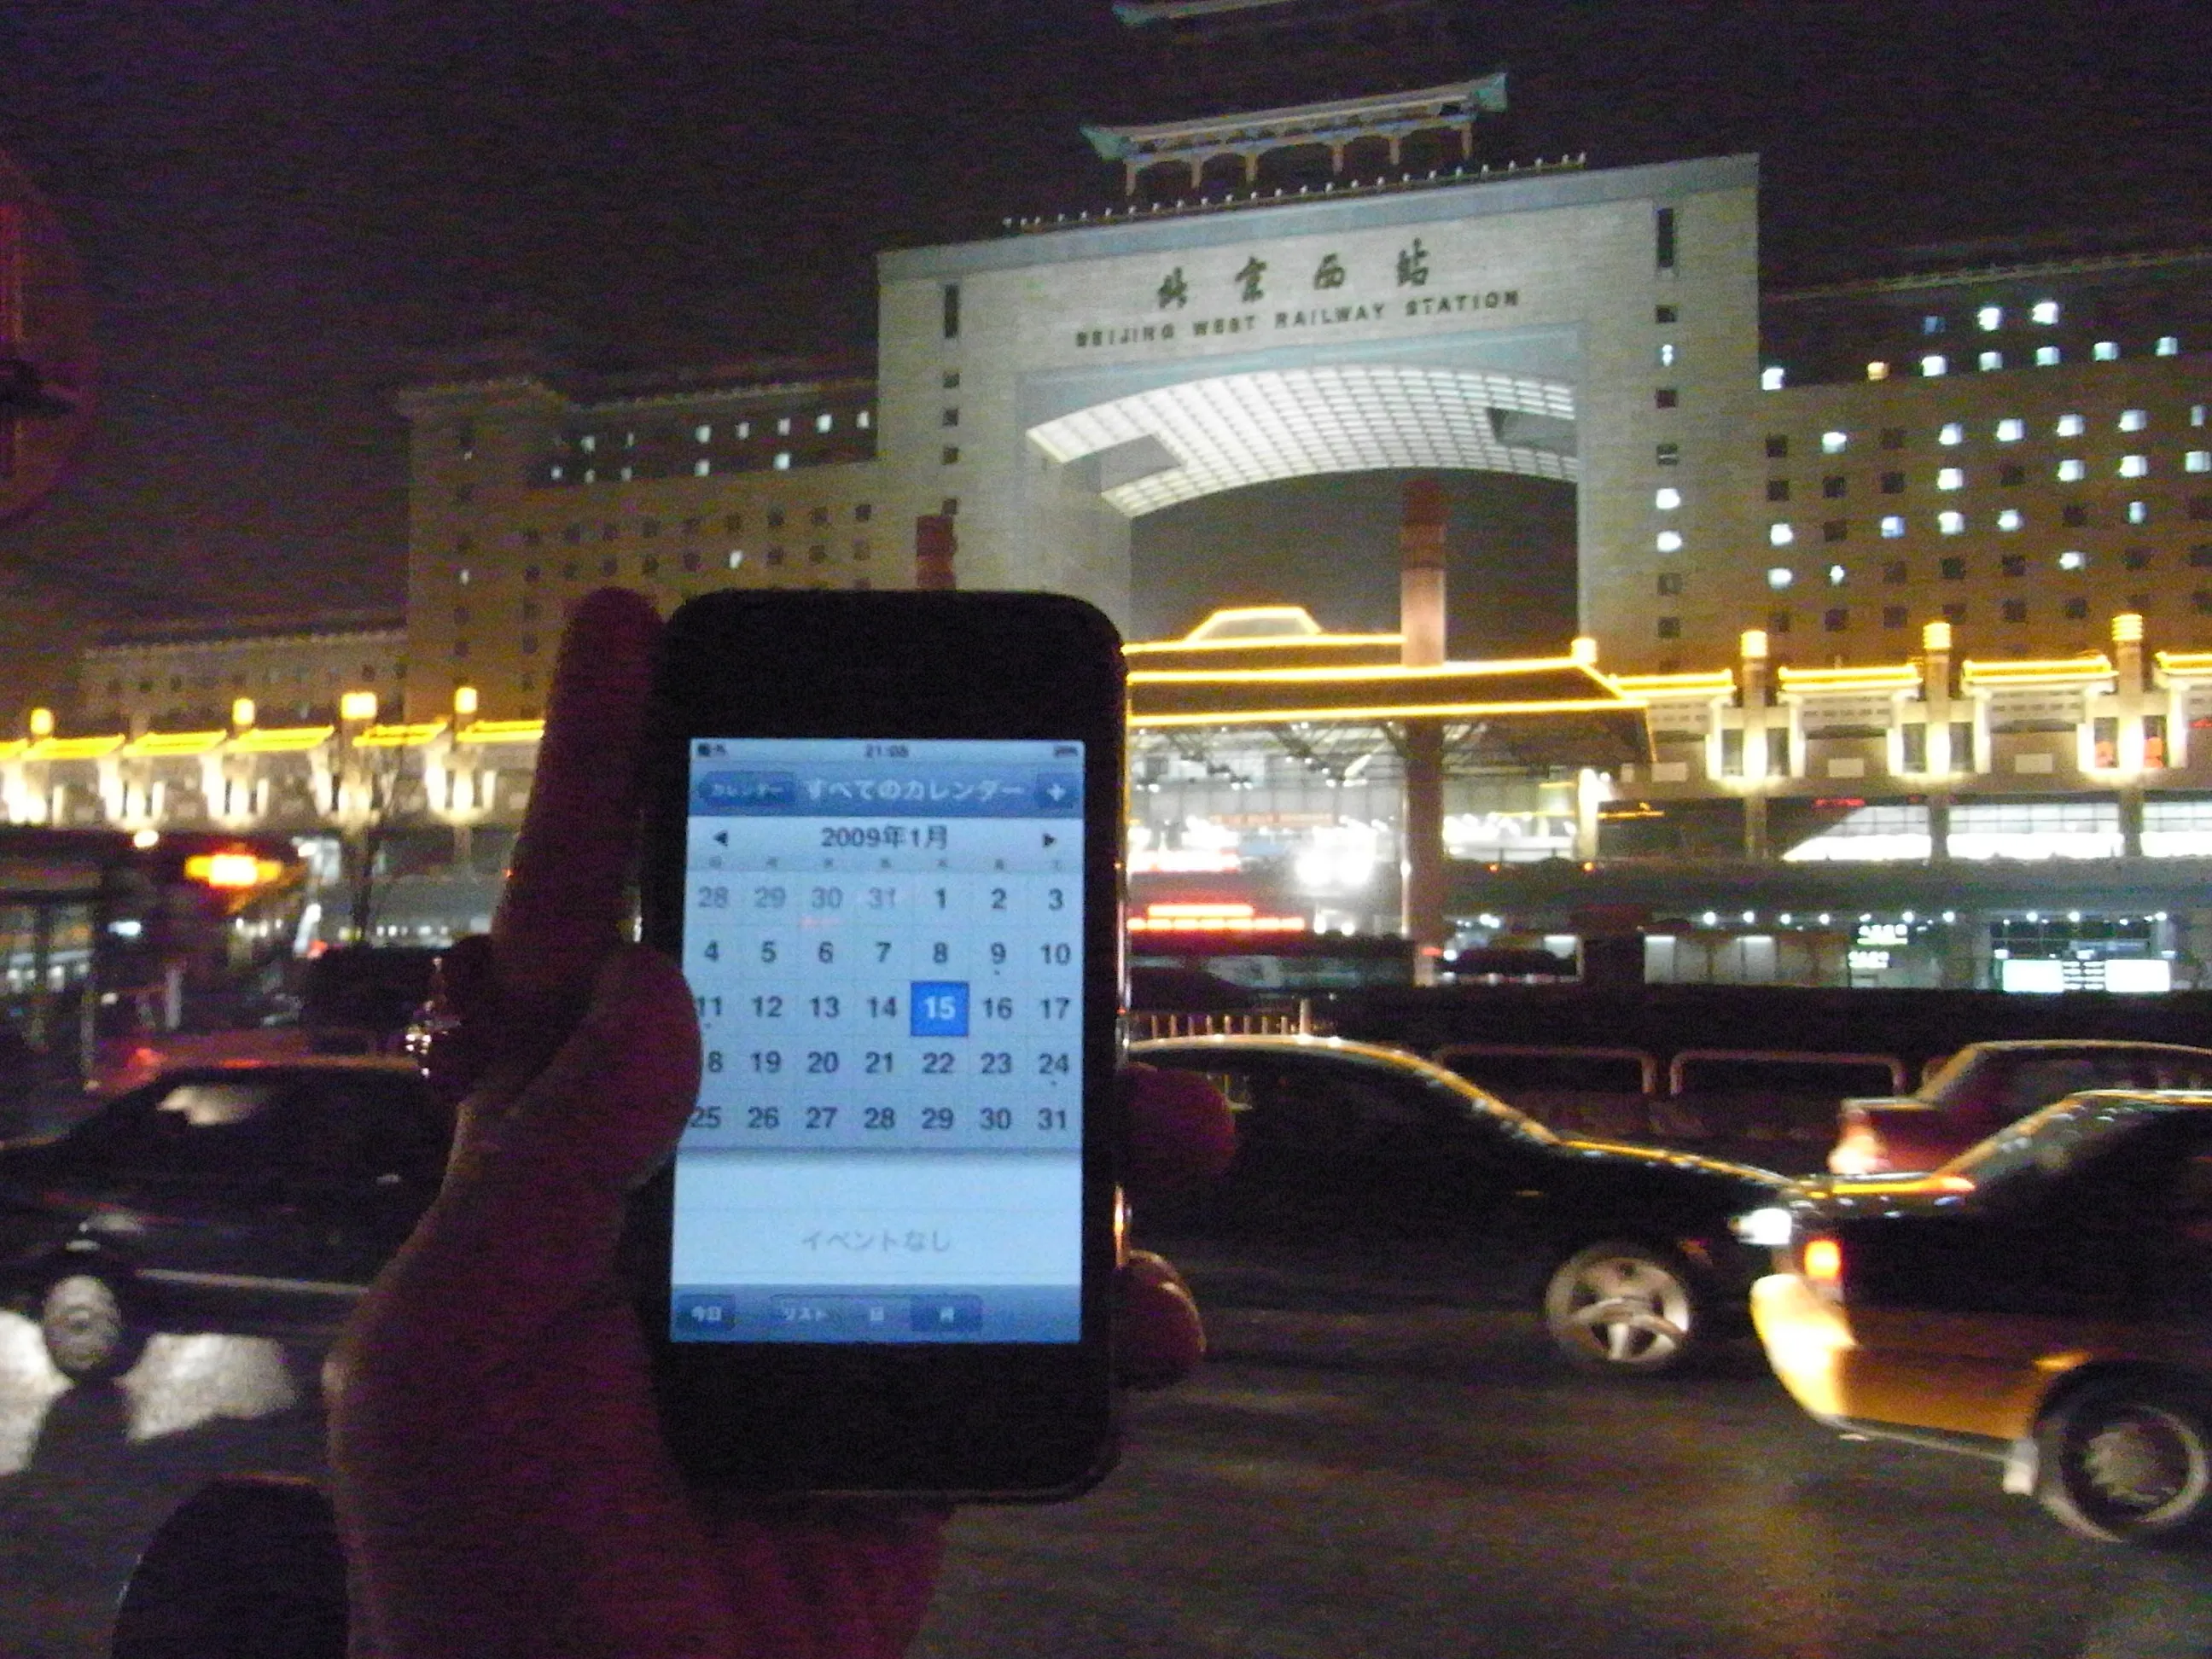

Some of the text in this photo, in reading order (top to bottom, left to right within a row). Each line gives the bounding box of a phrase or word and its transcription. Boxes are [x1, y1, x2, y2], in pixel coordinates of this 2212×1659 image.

[1157, 237, 1429, 310] 北京西站
[1075, 290, 1519, 348] BEIJING WEST RAILWAY STATION
[805, 777, 1022, 802] すべてのカレンダー
[821, 825, 948, 850] 2009年1月
[698, 886, 1064, 911] 28 29 30 31 1 2 3
[704, 940, 1072, 965] 4 5 6 7 8 9 10
[753, 995, 783, 1018] 12
[811, 996, 840, 1018] 13
[869, 996, 897, 1018] 14
[925, 996, 956, 1020] 15
[983, 997, 1013, 1020] 16
[1041, 997, 1071, 1019] 17
[751, 1051, 782, 1074] 19
[807, 1051, 840, 1074] 20
[865, 1051, 894, 1074] 21
[923, 1051, 955, 1074] 22
[981, 1051, 1012, 1075] 23
[1039, 1052, 1070, 1074] 24
[690, 1105, 1066, 1131] 25 26 27 28 29 30 31
[801, 1228, 951, 1253] イベントなし
